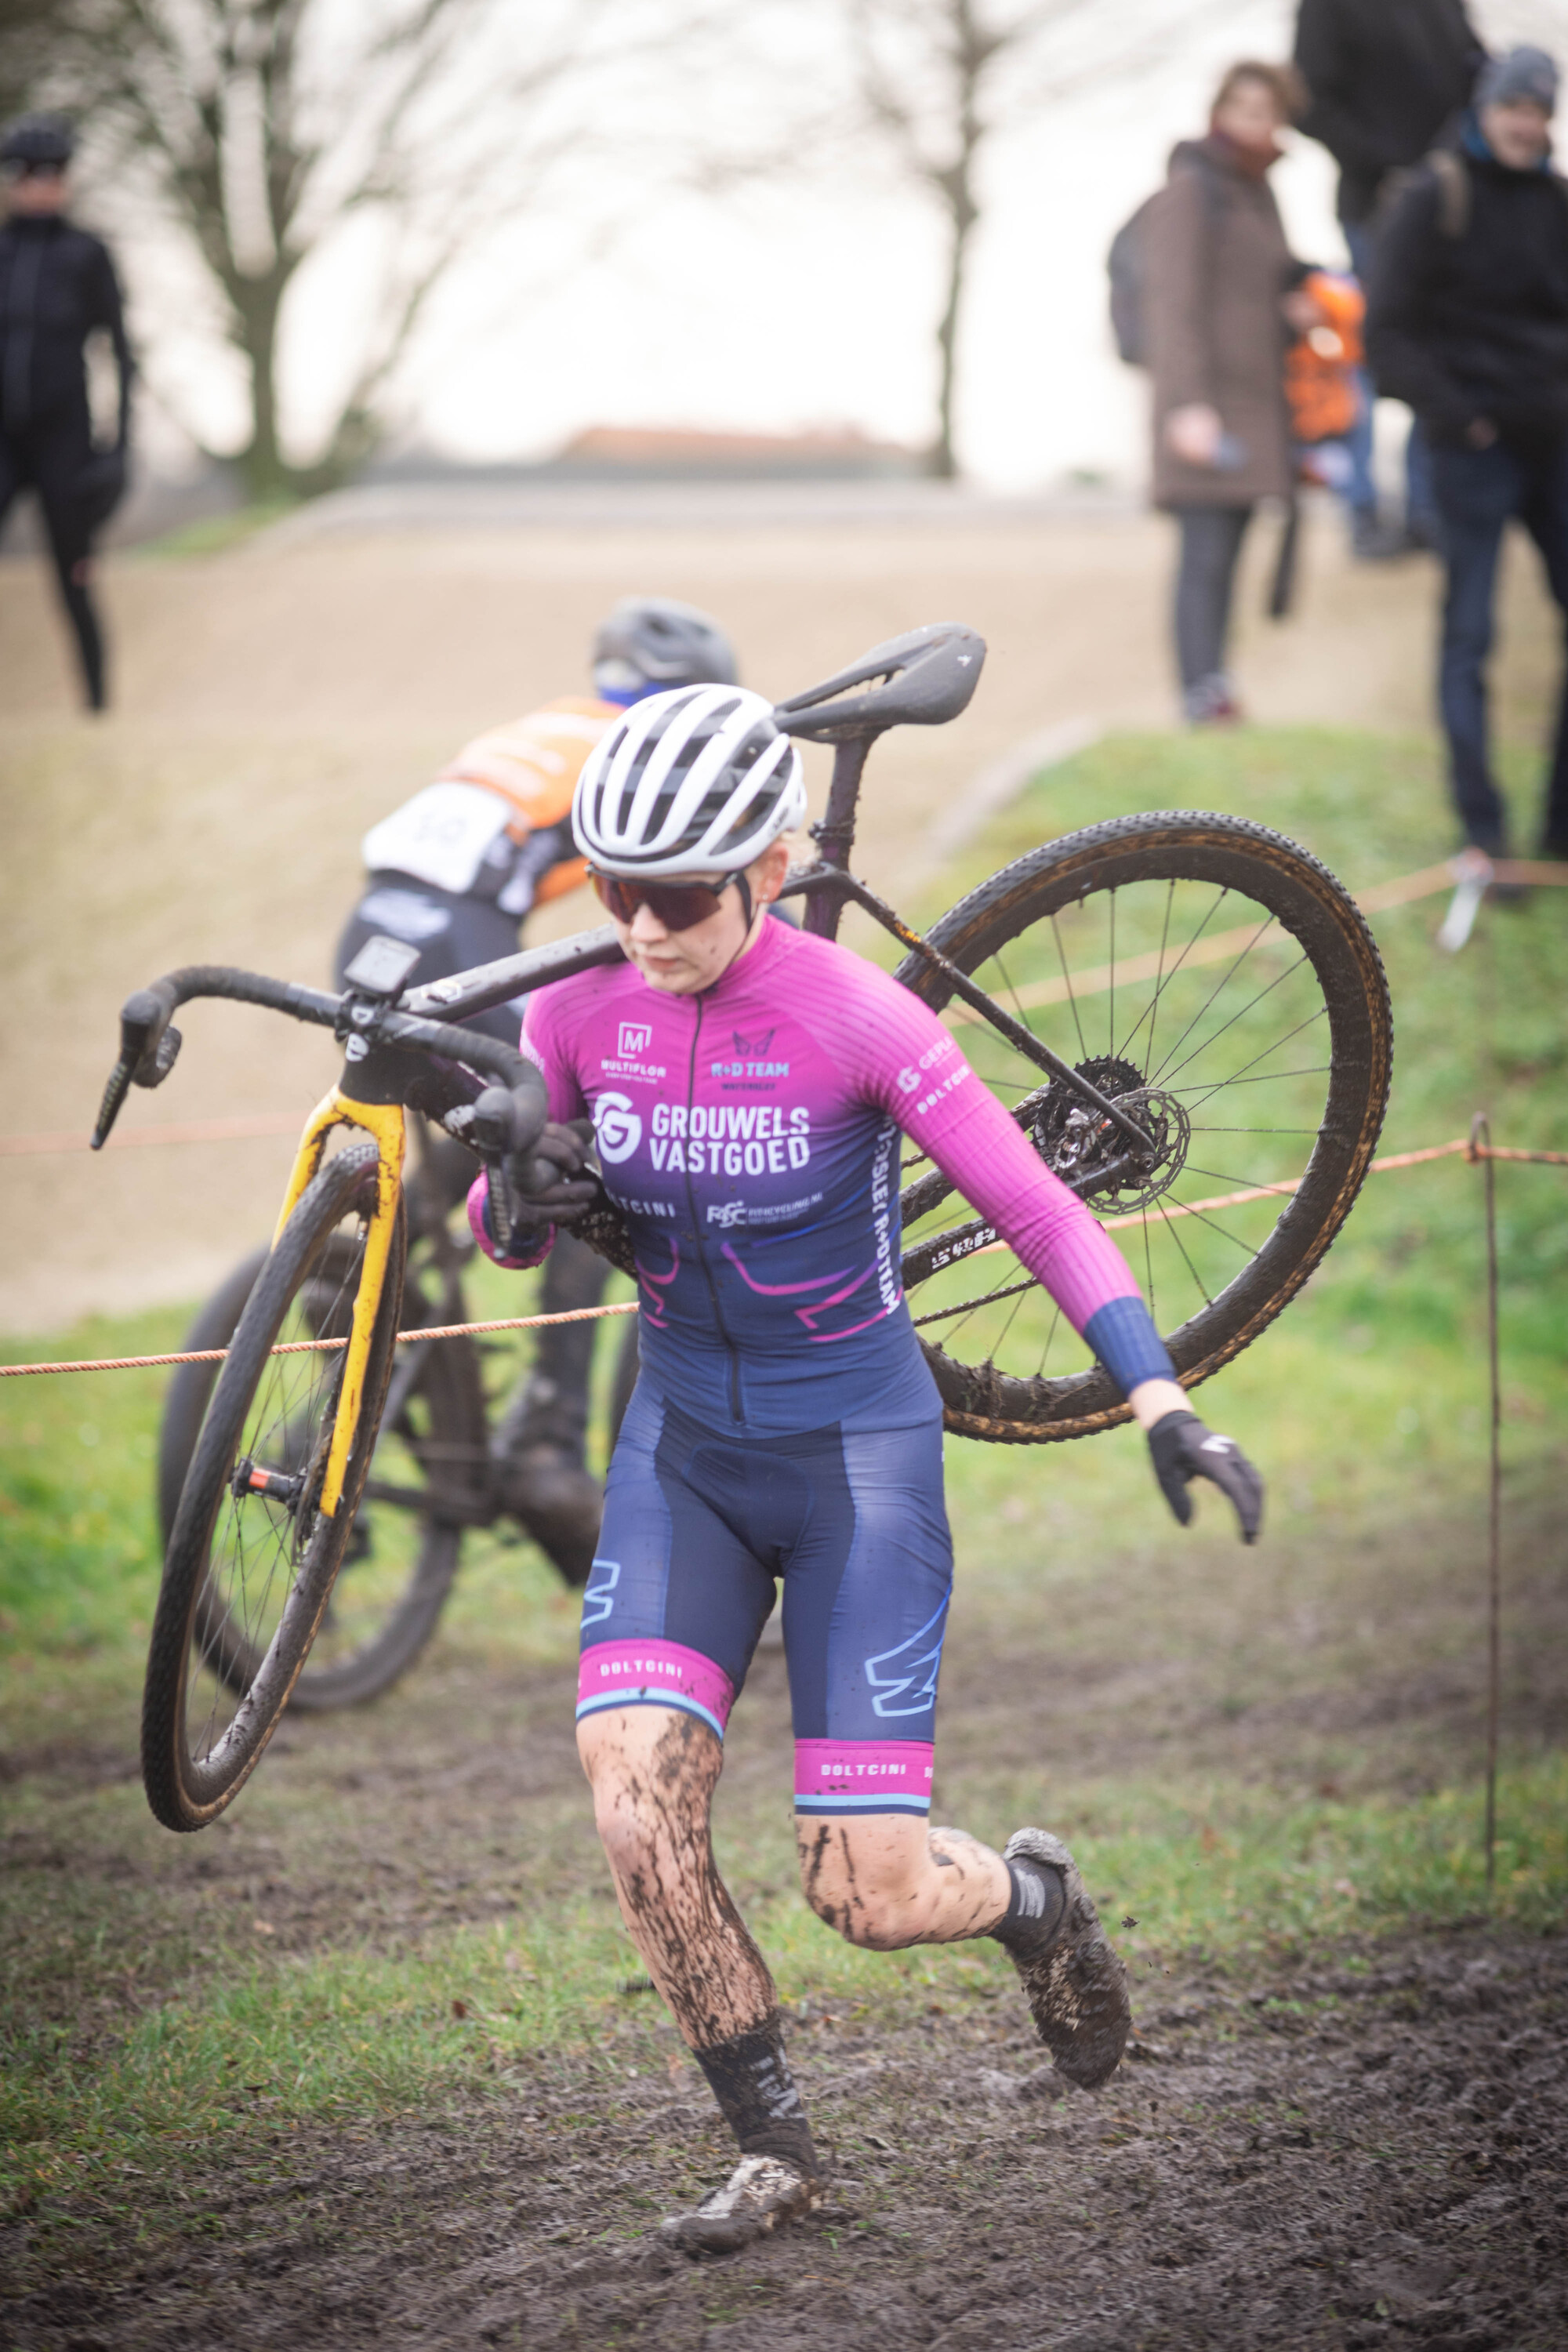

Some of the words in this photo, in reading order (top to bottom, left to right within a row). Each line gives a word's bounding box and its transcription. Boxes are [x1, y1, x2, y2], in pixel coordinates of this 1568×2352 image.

[624, 1029, 644, 1053] M
[601, 1059, 666, 1078] MULTIFLOR
[711, 1062, 744, 1078] R+D
[746, 1062, 789, 1078] TEAM
[651, 1102, 811, 1139] GROUWELS
[648, 1135, 811, 1177] VASTGOED
[877, 1254, 901, 1316] TEAM
[600, 1659, 683, 1679] DOLTCINI
[820, 1764, 907, 1777] DOLTCINI
